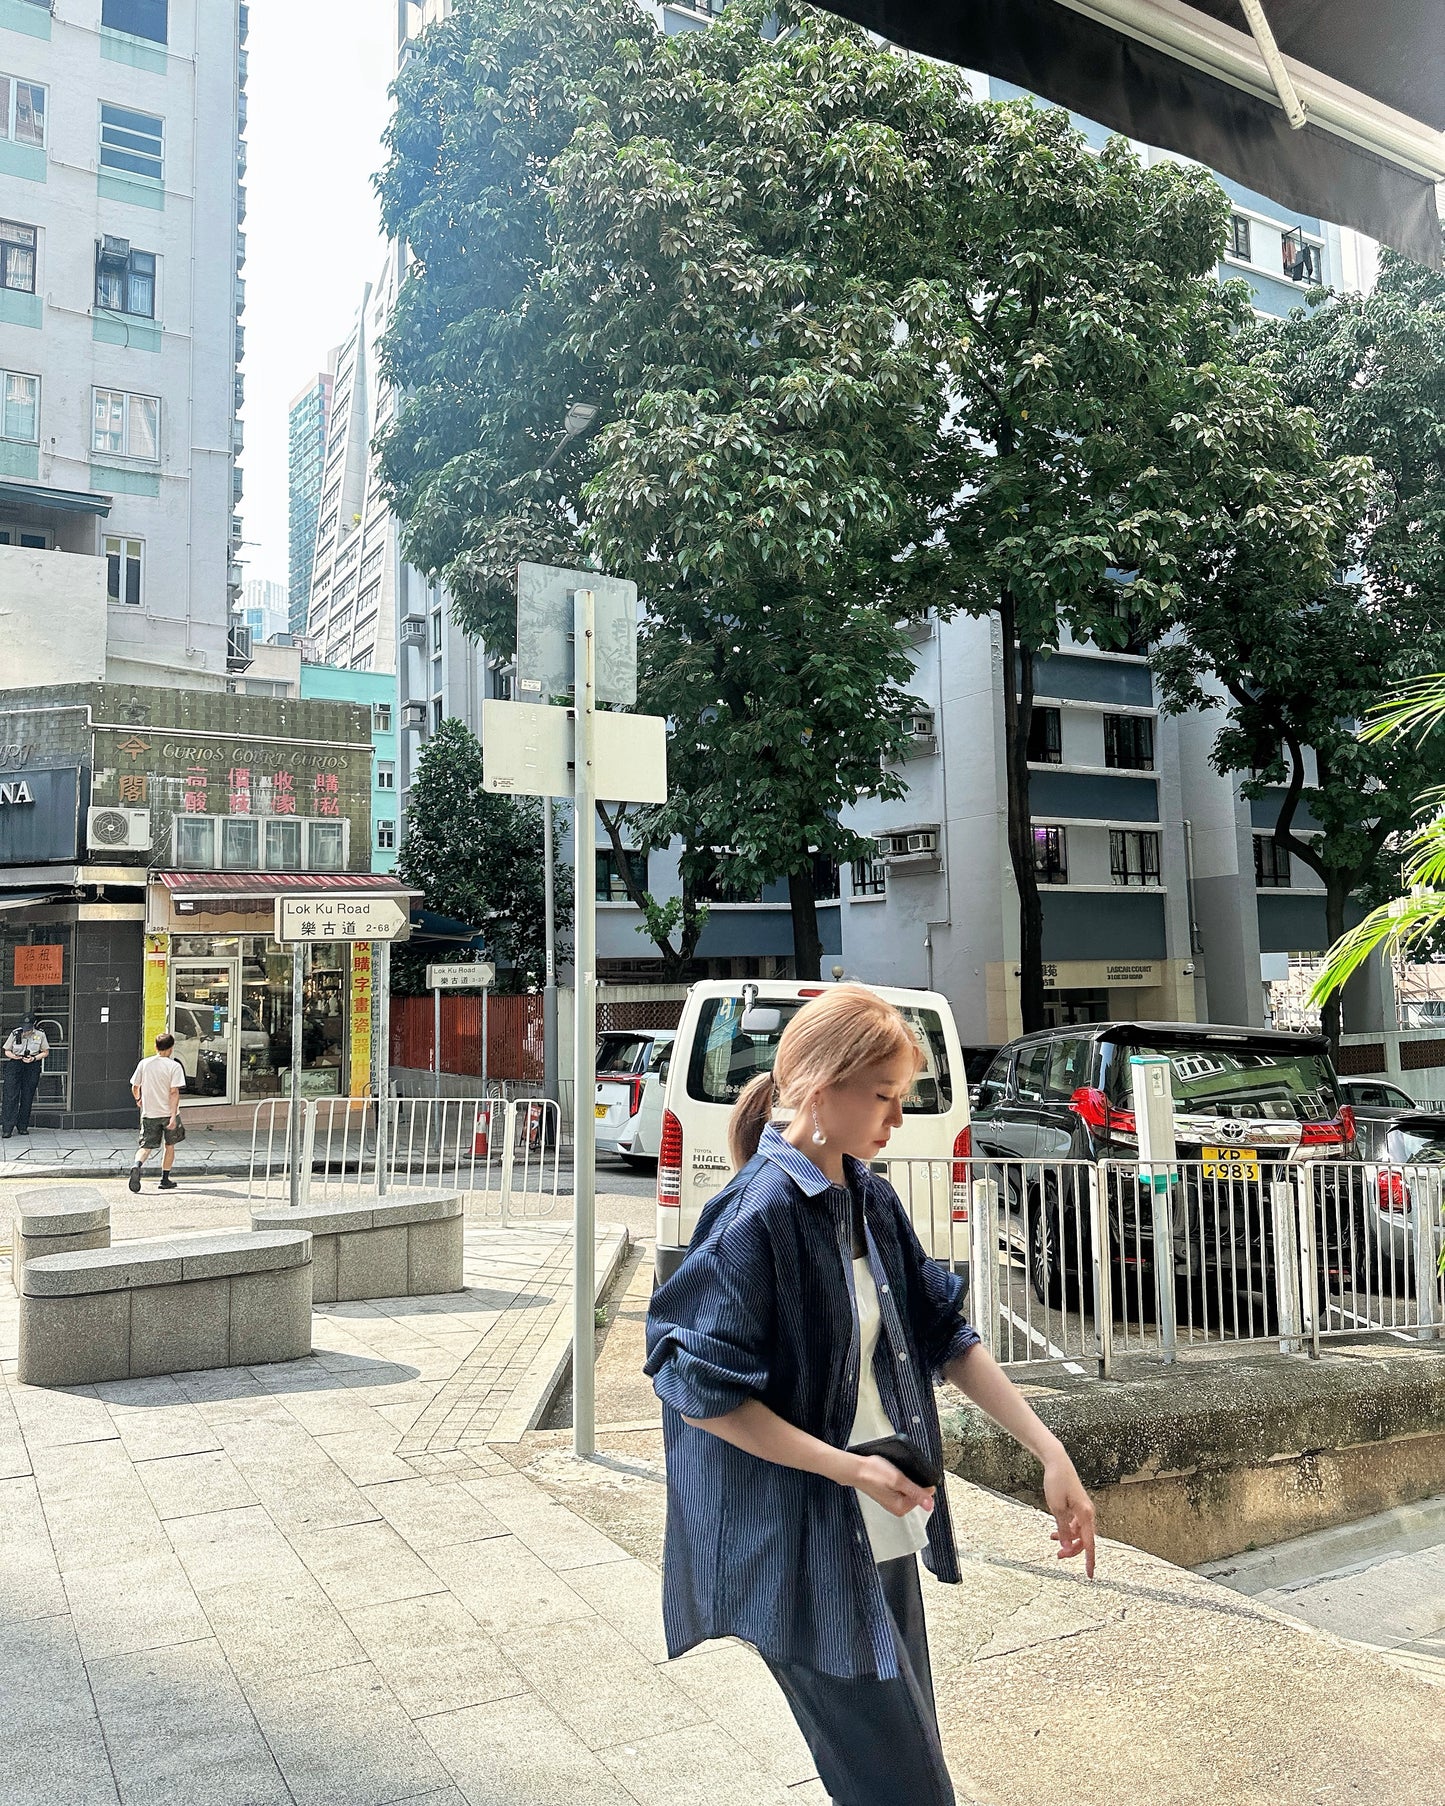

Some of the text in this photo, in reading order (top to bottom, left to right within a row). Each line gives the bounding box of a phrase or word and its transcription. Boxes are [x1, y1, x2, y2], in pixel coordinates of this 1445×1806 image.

[162, 743, 350, 769] CURIOS COURT CURIOS
[186, 766, 339, 794] 高價收購
[184, 791, 340, 816] 酸枝傢私
[287, 903, 370, 914] Lok Ku Road
[301, 921, 390, 936] 樂古道 2-68
[693, 1154, 727, 1163] HIACE
[1207, 1163, 1255, 1179] 2983
